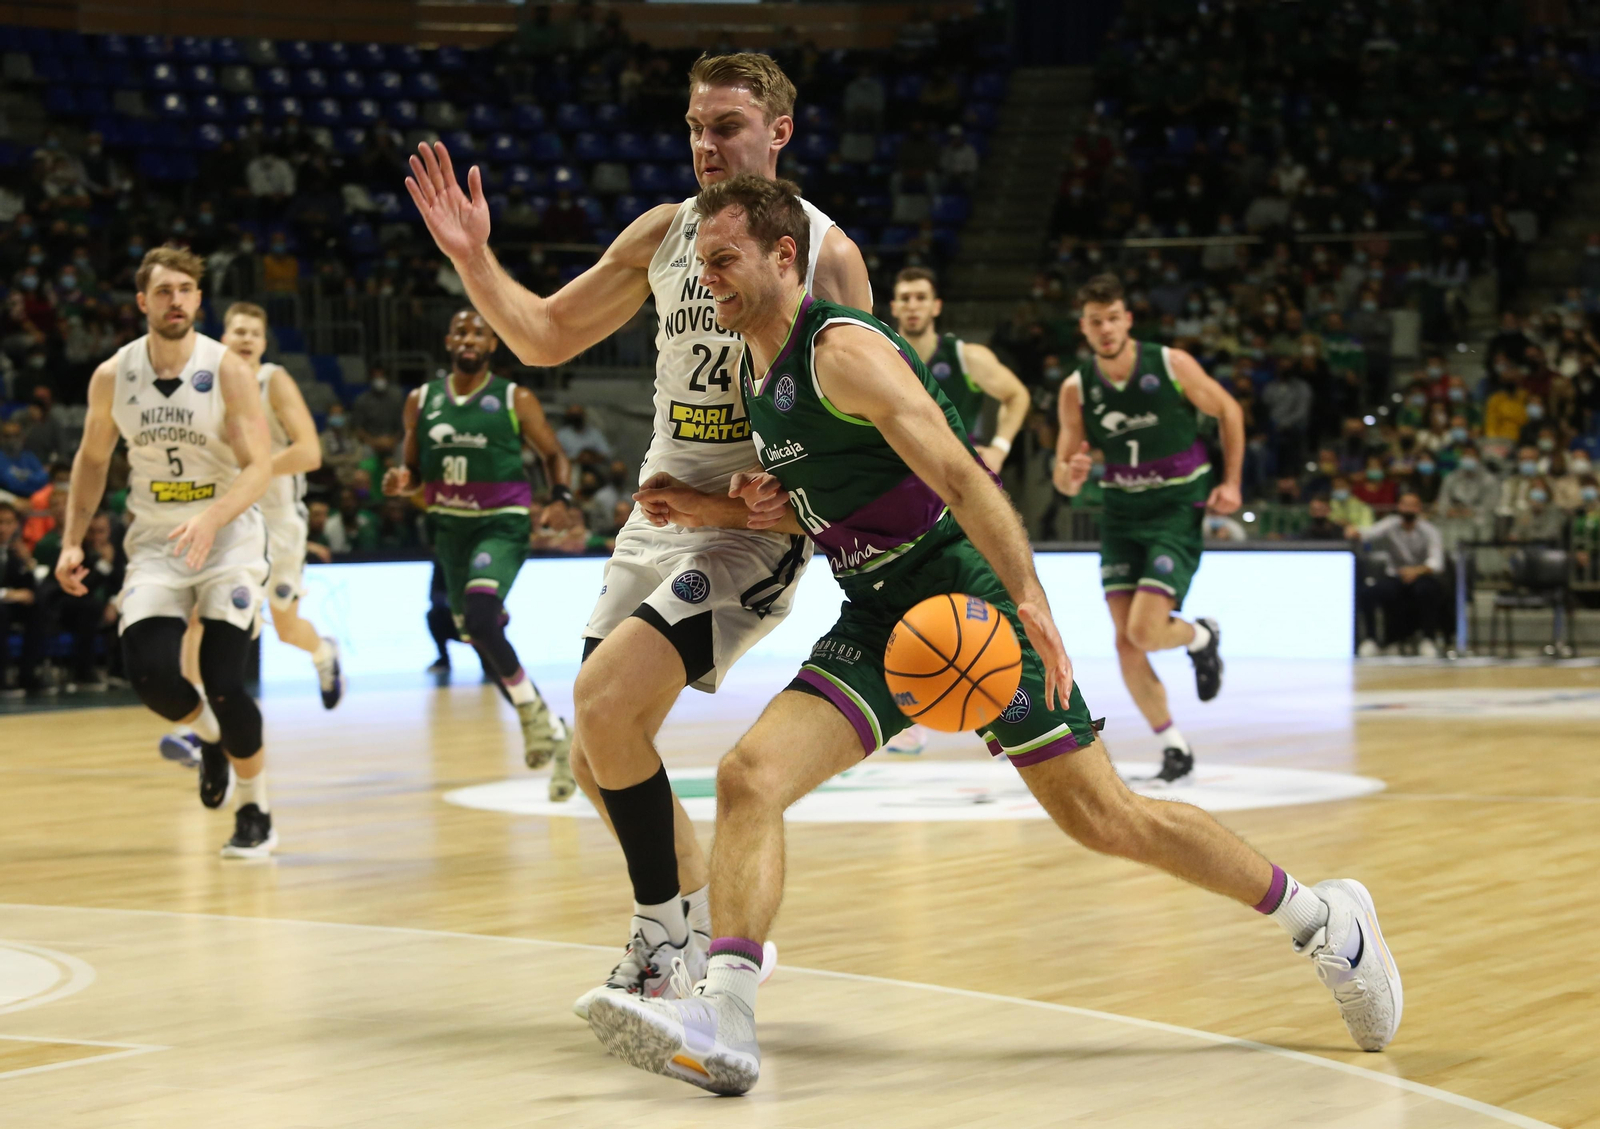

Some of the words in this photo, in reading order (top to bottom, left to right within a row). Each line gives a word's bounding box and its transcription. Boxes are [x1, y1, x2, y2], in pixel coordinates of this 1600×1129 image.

[681, 275, 714, 302] NIZ
[665, 305, 742, 340] NOVG
[689, 343, 732, 393] 24
[141, 406, 194, 427] NIZHNY
[672, 405, 728, 424] PARI
[166, 447, 183, 477] 5
[765, 439, 804, 462] Unicaja
[1126, 440, 1139, 468] 1
[442, 455, 468, 486] 30
[788, 487, 832, 535] 21
